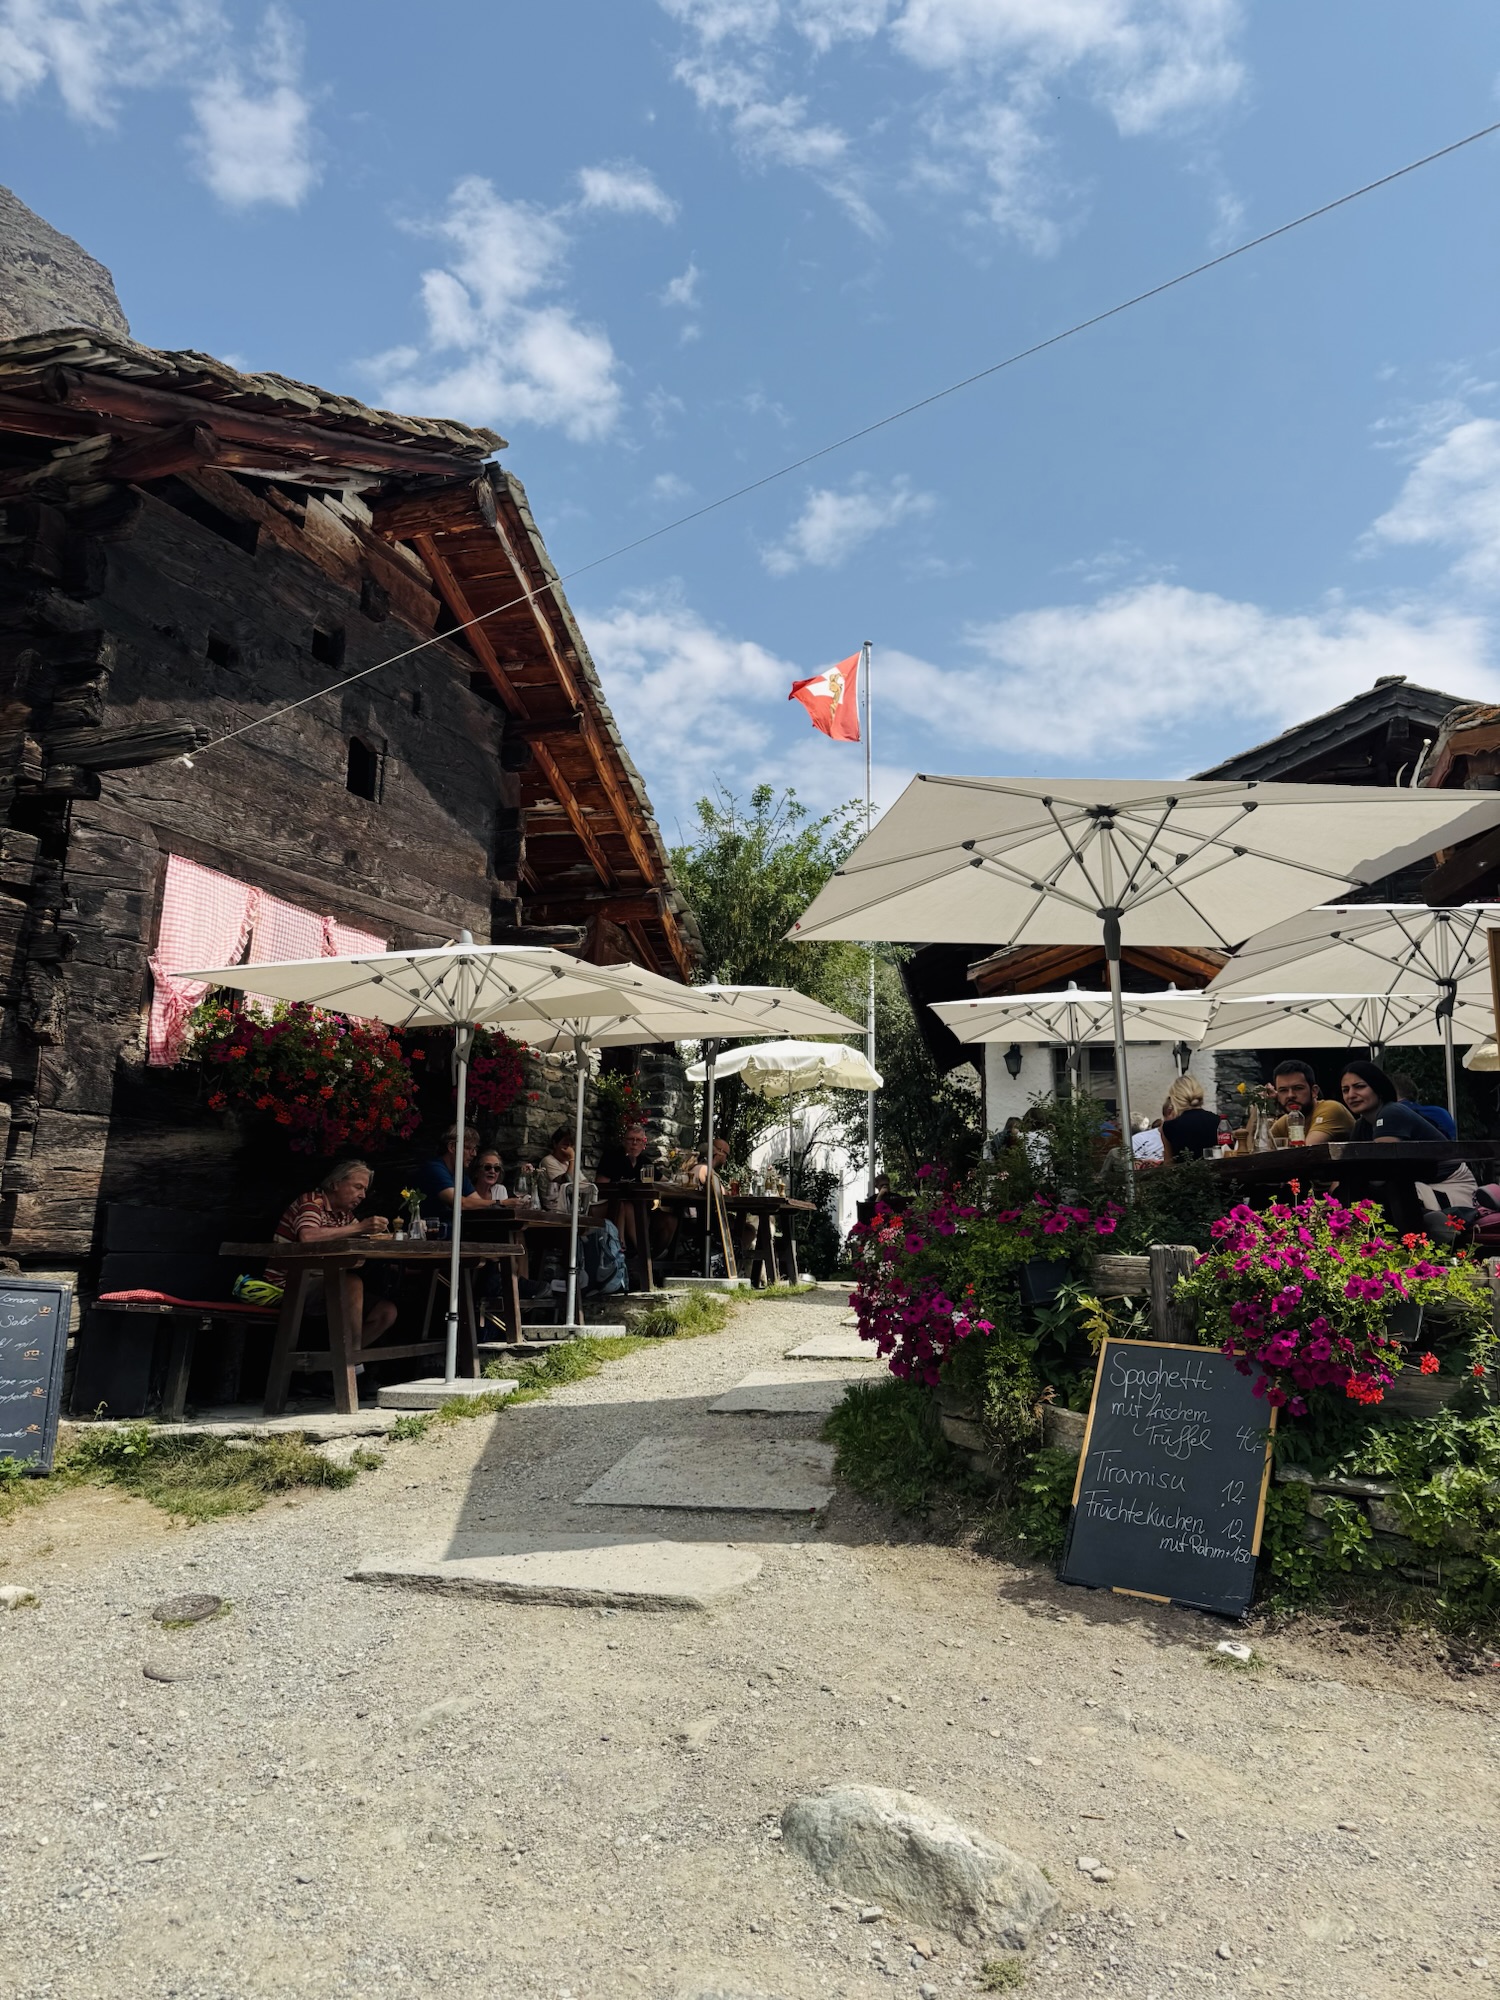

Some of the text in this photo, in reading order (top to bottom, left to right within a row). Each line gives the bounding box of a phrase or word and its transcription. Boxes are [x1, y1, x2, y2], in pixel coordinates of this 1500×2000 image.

[1110, 1351, 1213, 1400] Spaghetti
[1111, 1387, 1212, 1436] mit frischem
[1092, 1449, 1186, 1492] Tiramisu
[1159, 1532, 1189, 1553] mit
